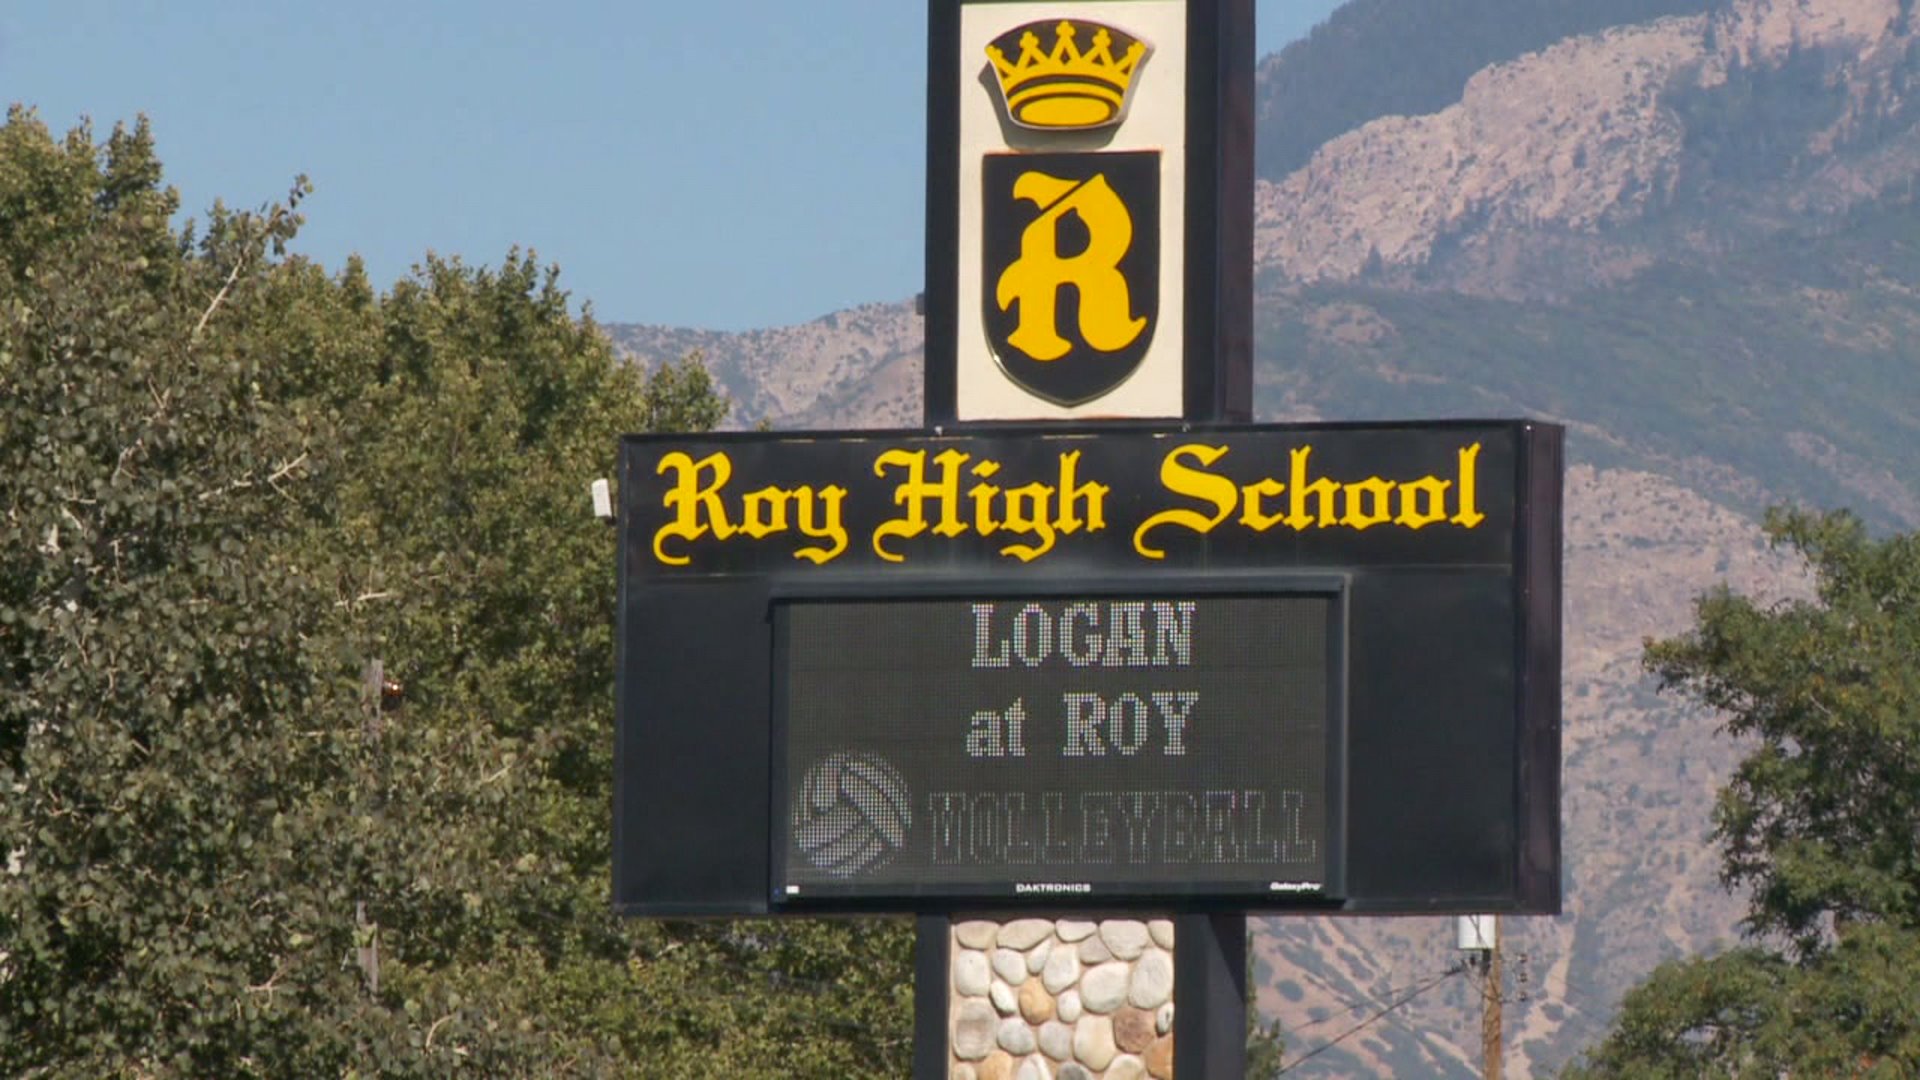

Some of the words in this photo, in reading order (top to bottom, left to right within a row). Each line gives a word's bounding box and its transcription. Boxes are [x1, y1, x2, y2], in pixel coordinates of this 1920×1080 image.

[996, 171, 1147, 361] R
[653, 451, 848, 566] Roy
[872, 449, 1109, 563] High
[1133, 442, 1484, 559] School
[971, 601, 1197, 668] LOGAN
[966, 698, 1026, 757] at
[1063, 692, 1200, 756] ROY
[929, 791, 1317, 864] VOLLEYBALL
[1015, 882, 1092, 893] DAKTRONICS
